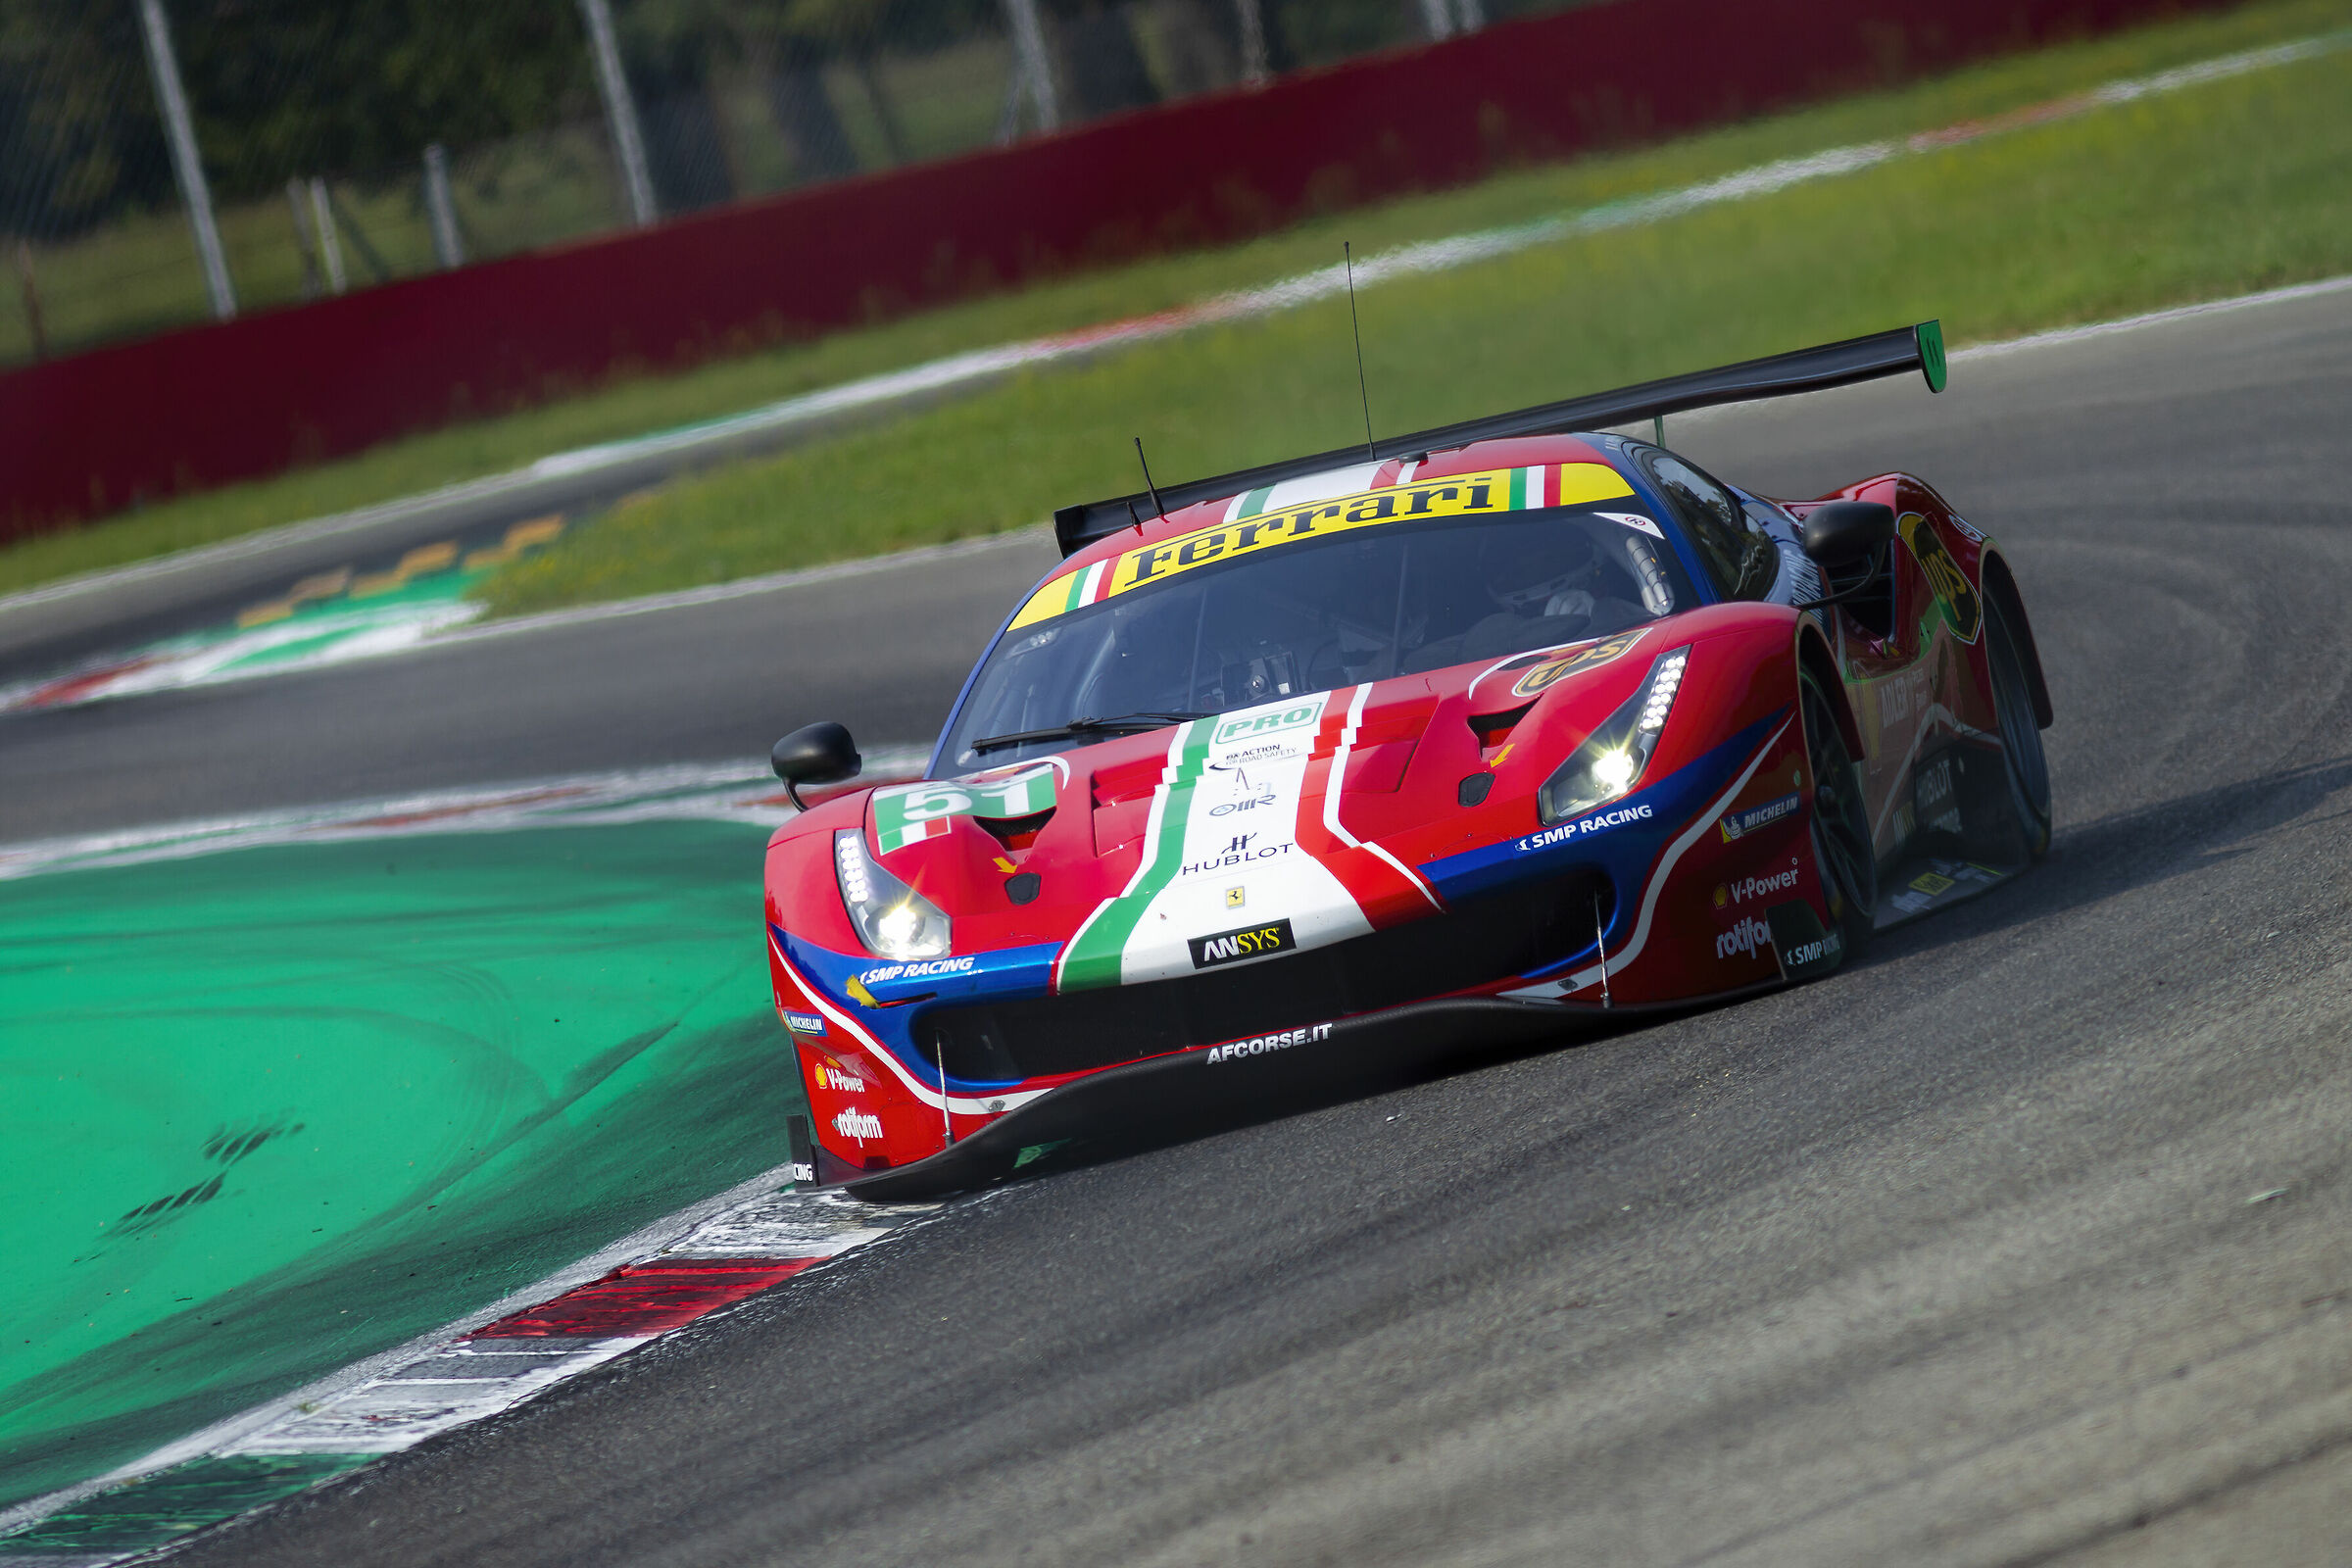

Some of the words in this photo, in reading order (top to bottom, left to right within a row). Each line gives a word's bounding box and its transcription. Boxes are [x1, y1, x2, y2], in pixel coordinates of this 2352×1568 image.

[1123, 476, 1494, 588] Ferrari
[1223, 707, 1313, 738] PRO
[1238, 755, 1263, 764] ROAD
[1263, 747, 1297, 759] SAFETY
[1242, 744, 1281, 758] ACTION
[902, 778, 1030, 821] 51
[1743, 795, 1798, 829] MICHELIN
[1532, 824, 1577, 849] SMP
[1579, 805, 1653, 834] RACING
[1183, 843, 1294, 876] HUBLOT
[1731, 868, 1799, 905] V-Power
[1203, 927, 1280, 961] ANSYS
[1716, 915, 1773, 960] rotifor
[1794, 940, 1823, 965] SMP
[865, 964, 903, 985] SMP
[903, 956, 975, 978] RACING
[790, 1015, 823, 1031] MICHELIN
[1206, 1023, 1333, 1065] AFCORSE.IT
[825, 1068, 865, 1093] V-Power
[837, 1105, 884, 1149] rotiform
